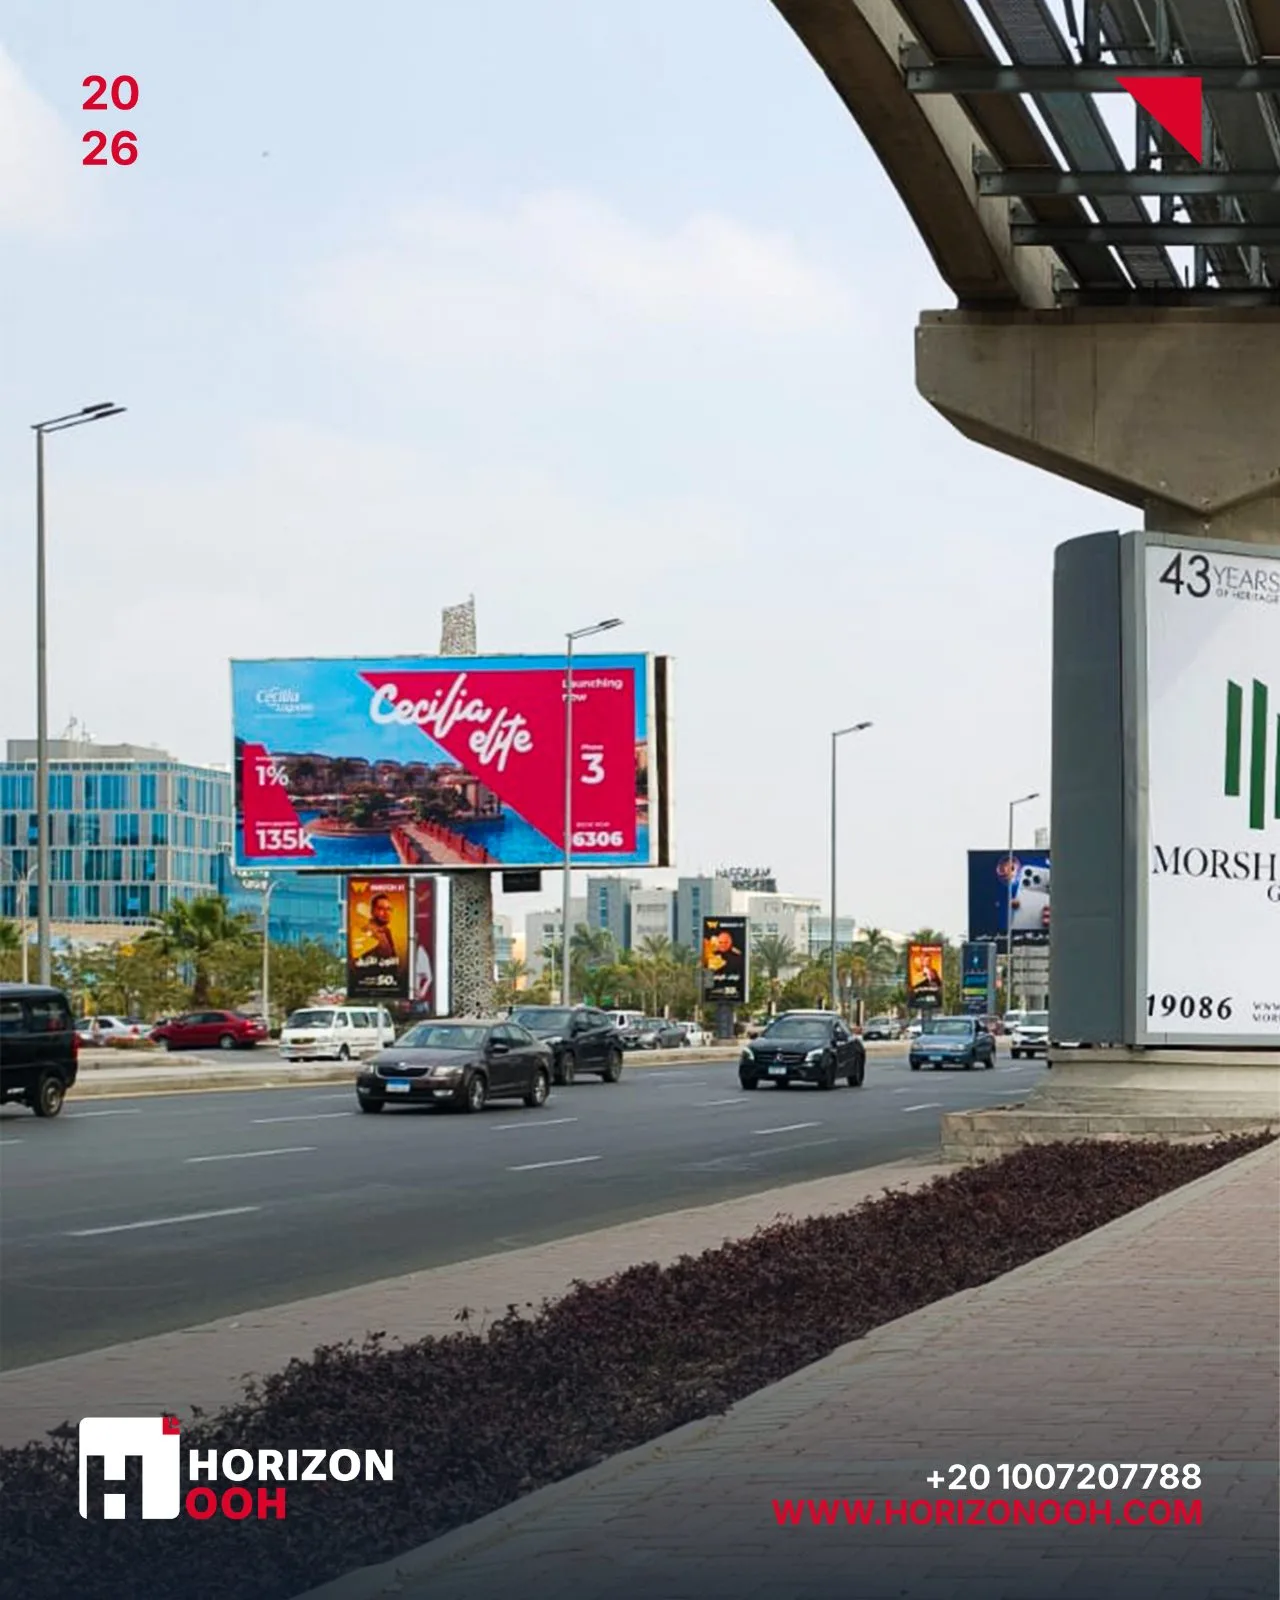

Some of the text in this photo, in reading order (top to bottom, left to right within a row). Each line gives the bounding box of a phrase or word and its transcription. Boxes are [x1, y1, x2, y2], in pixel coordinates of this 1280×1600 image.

[1159, 551, 1280, 598] 43 YEARS
[370, 673, 492, 739] Cecilia
[469, 707, 533, 772] elite
[255, 765, 289, 786] 1%
[580, 753, 605, 784] 3
[255, 828, 314, 850] 135k
[572, 831, 623, 847] 6306
[1147, 994, 1233, 1020] 19086
